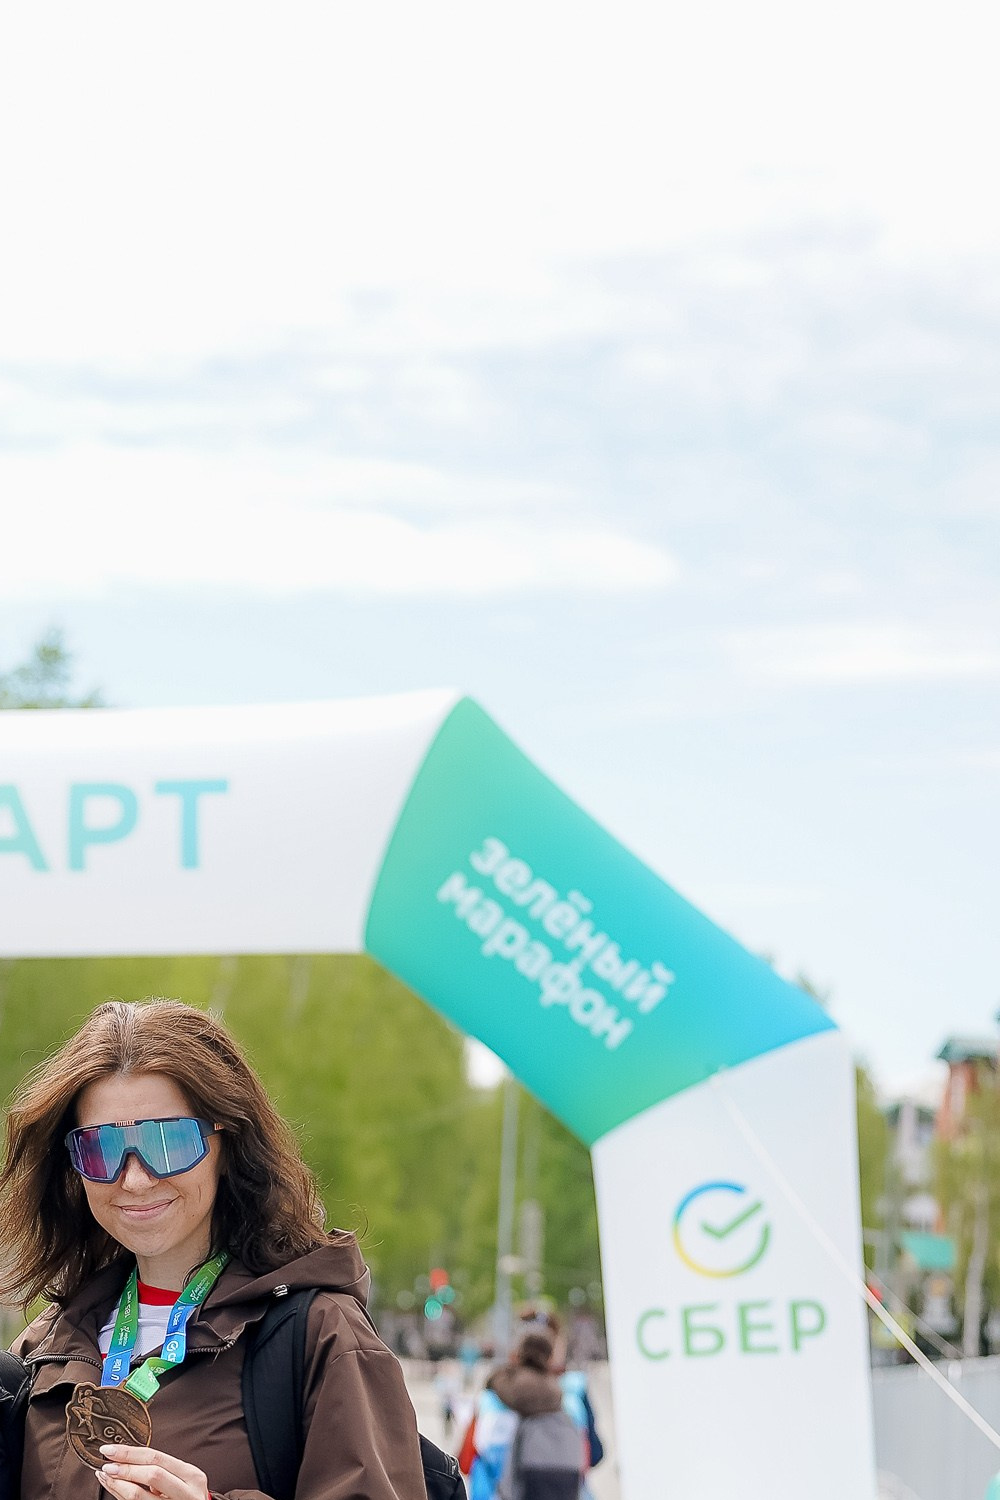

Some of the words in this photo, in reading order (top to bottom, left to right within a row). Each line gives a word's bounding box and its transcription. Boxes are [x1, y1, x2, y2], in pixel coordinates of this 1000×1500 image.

[437, 871, 634, 1050] марафон
[469, 837, 675, 1014] зелёный
[636, 1299, 827, 1361] СБЕР
